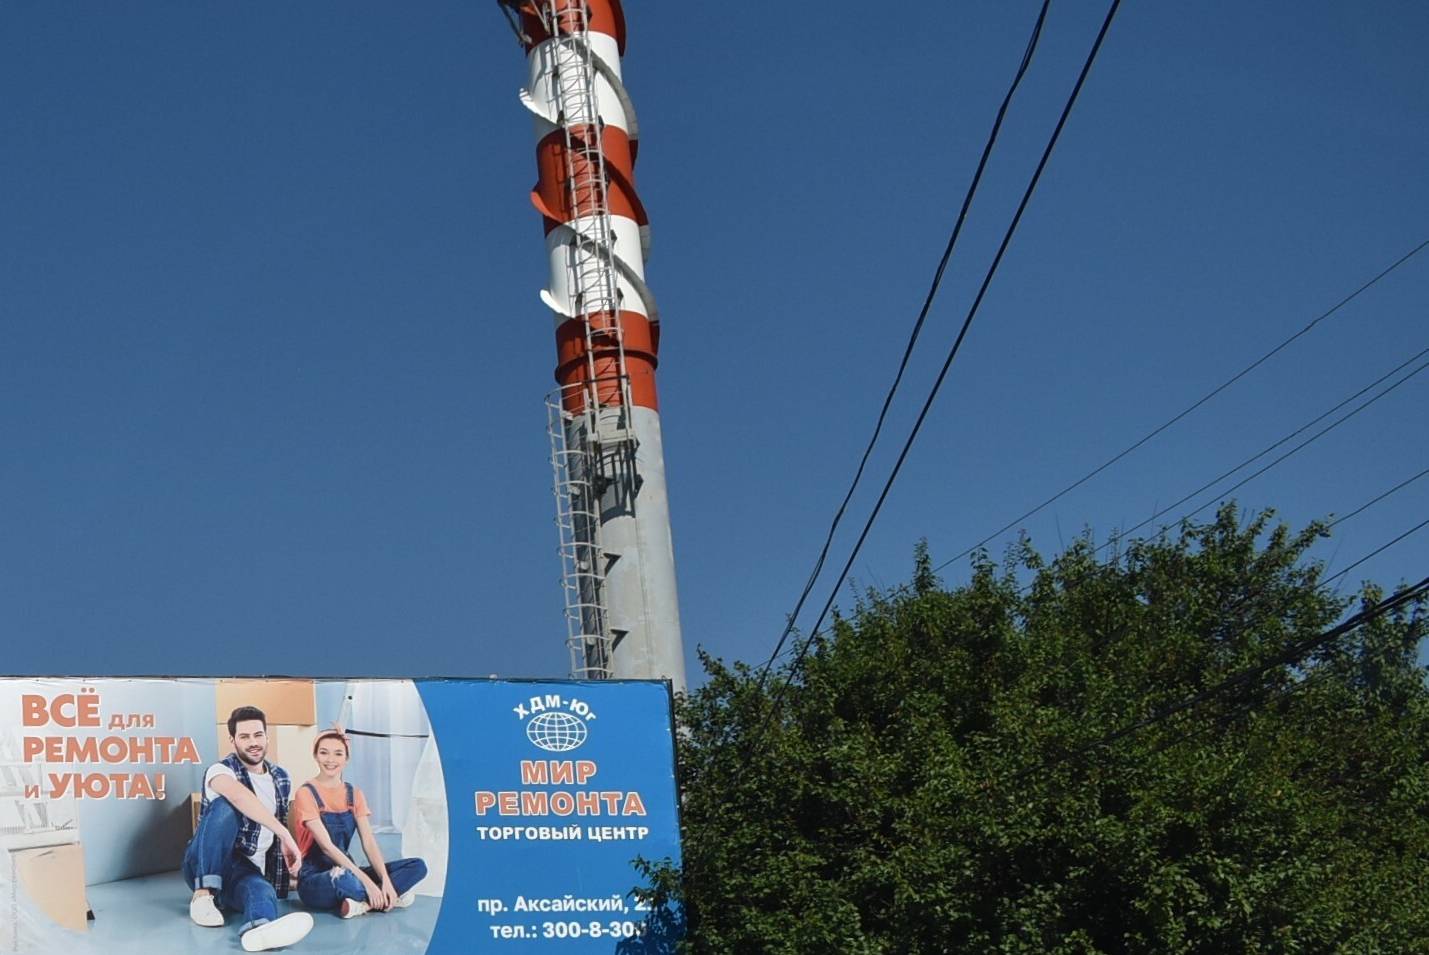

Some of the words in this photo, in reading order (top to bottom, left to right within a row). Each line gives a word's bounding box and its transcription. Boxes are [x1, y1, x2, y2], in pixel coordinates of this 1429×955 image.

[22, 687, 101, 728] ВСЁ
[108, 713, 155, 731] для
[23, 736, 202, 764] РЕМОНТА
[520, 760, 597, 785] МИР
[24, 784, 40, 799] и
[48, 772, 166, 800] УЮТА!
[474, 791, 647, 816] РЕМОНТА
[476, 824, 581, 840] ТОРГОВЫЙ
[587, 826, 649, 842] ЦЕНТР
[477, 898, 509, 916] пр.
[514, 894, 629, 915] Аксайский,
[490, 924, 538, 939] тел.:
